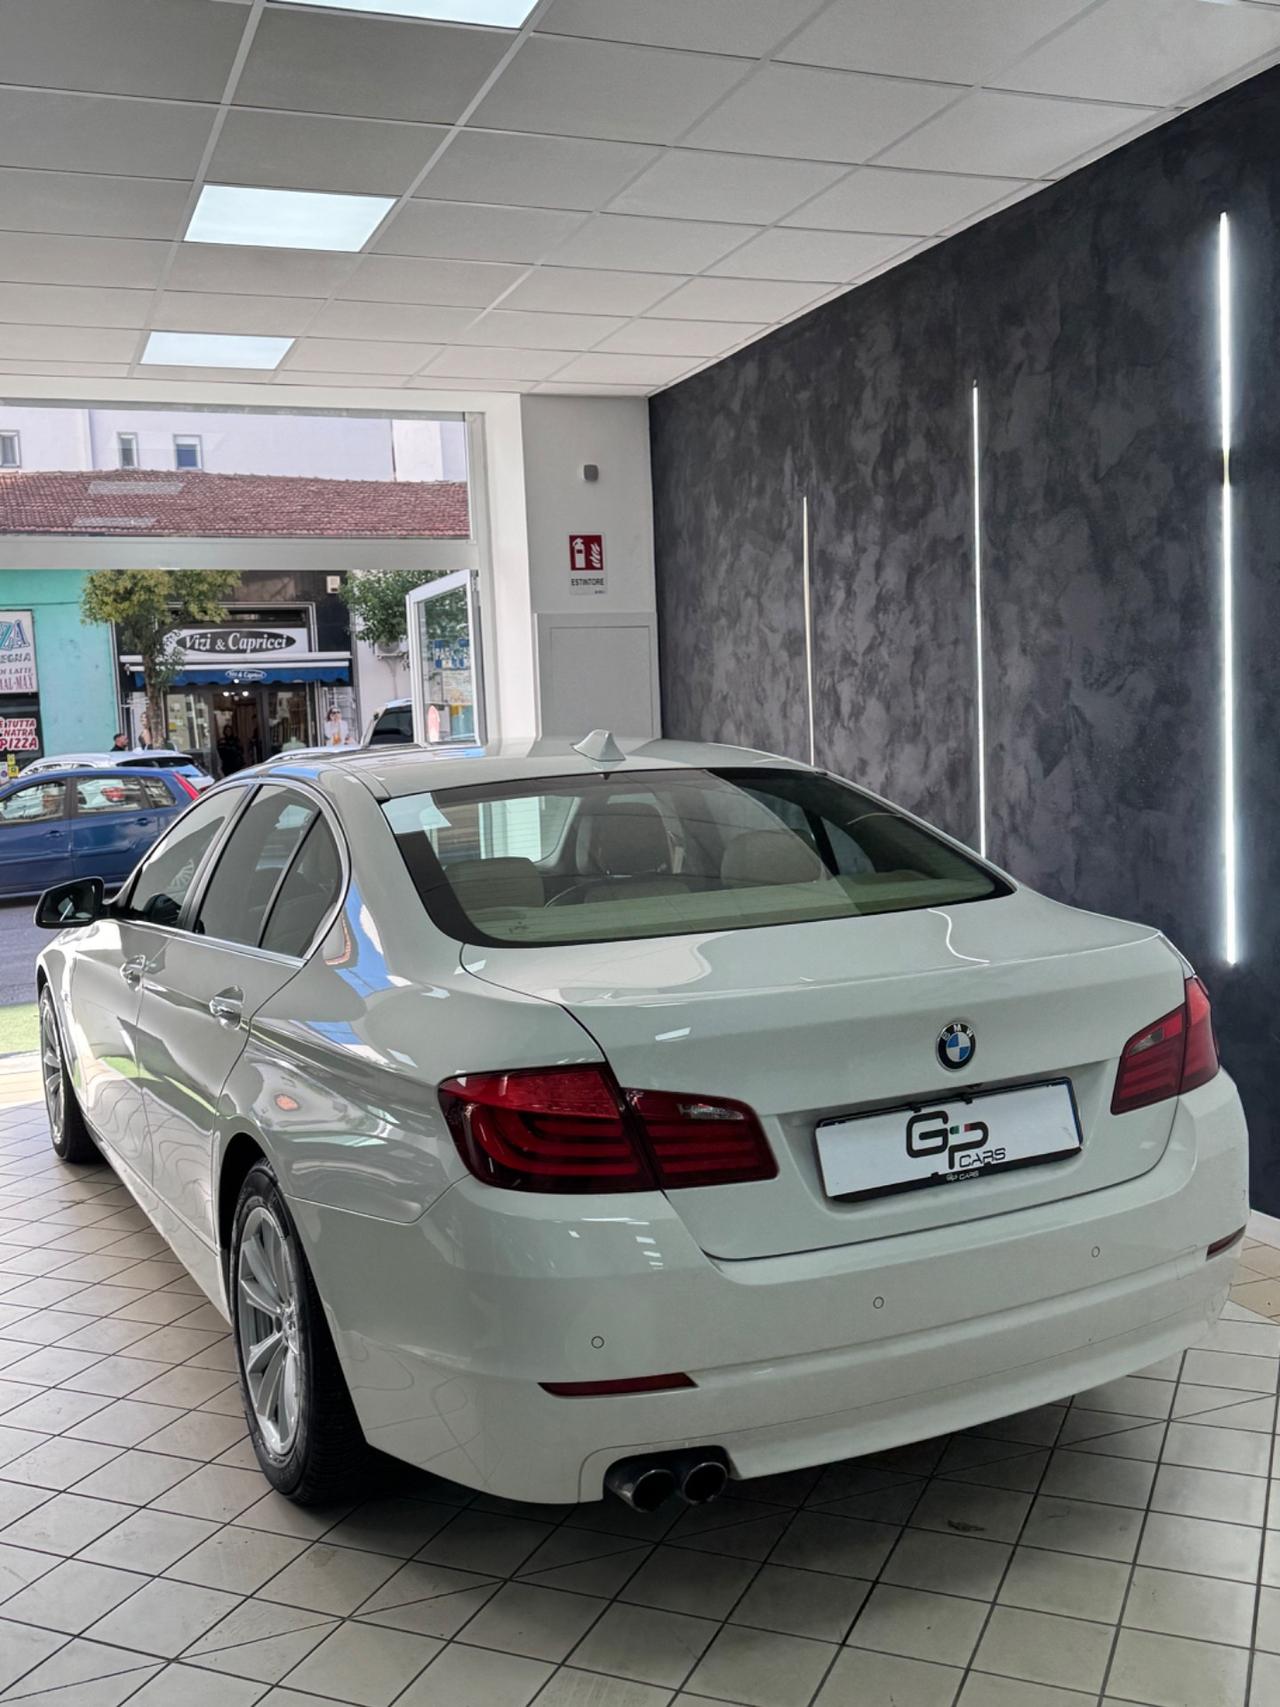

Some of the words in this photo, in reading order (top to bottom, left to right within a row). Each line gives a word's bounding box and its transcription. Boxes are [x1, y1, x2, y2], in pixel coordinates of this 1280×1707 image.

[570, 577, 605, 586] ESTINTORE
[185, 633, 212, 651] Vizi
[214, 639, 227, 651] &
[228, 632, 287, 653] Capricci
[7, 719, 36, 728] TUTTA
[0, 737, 37, 749] PIZZA
[959, 1147, 1006, 1168] CARS
[959, 1170, 979, 1180] CARS
